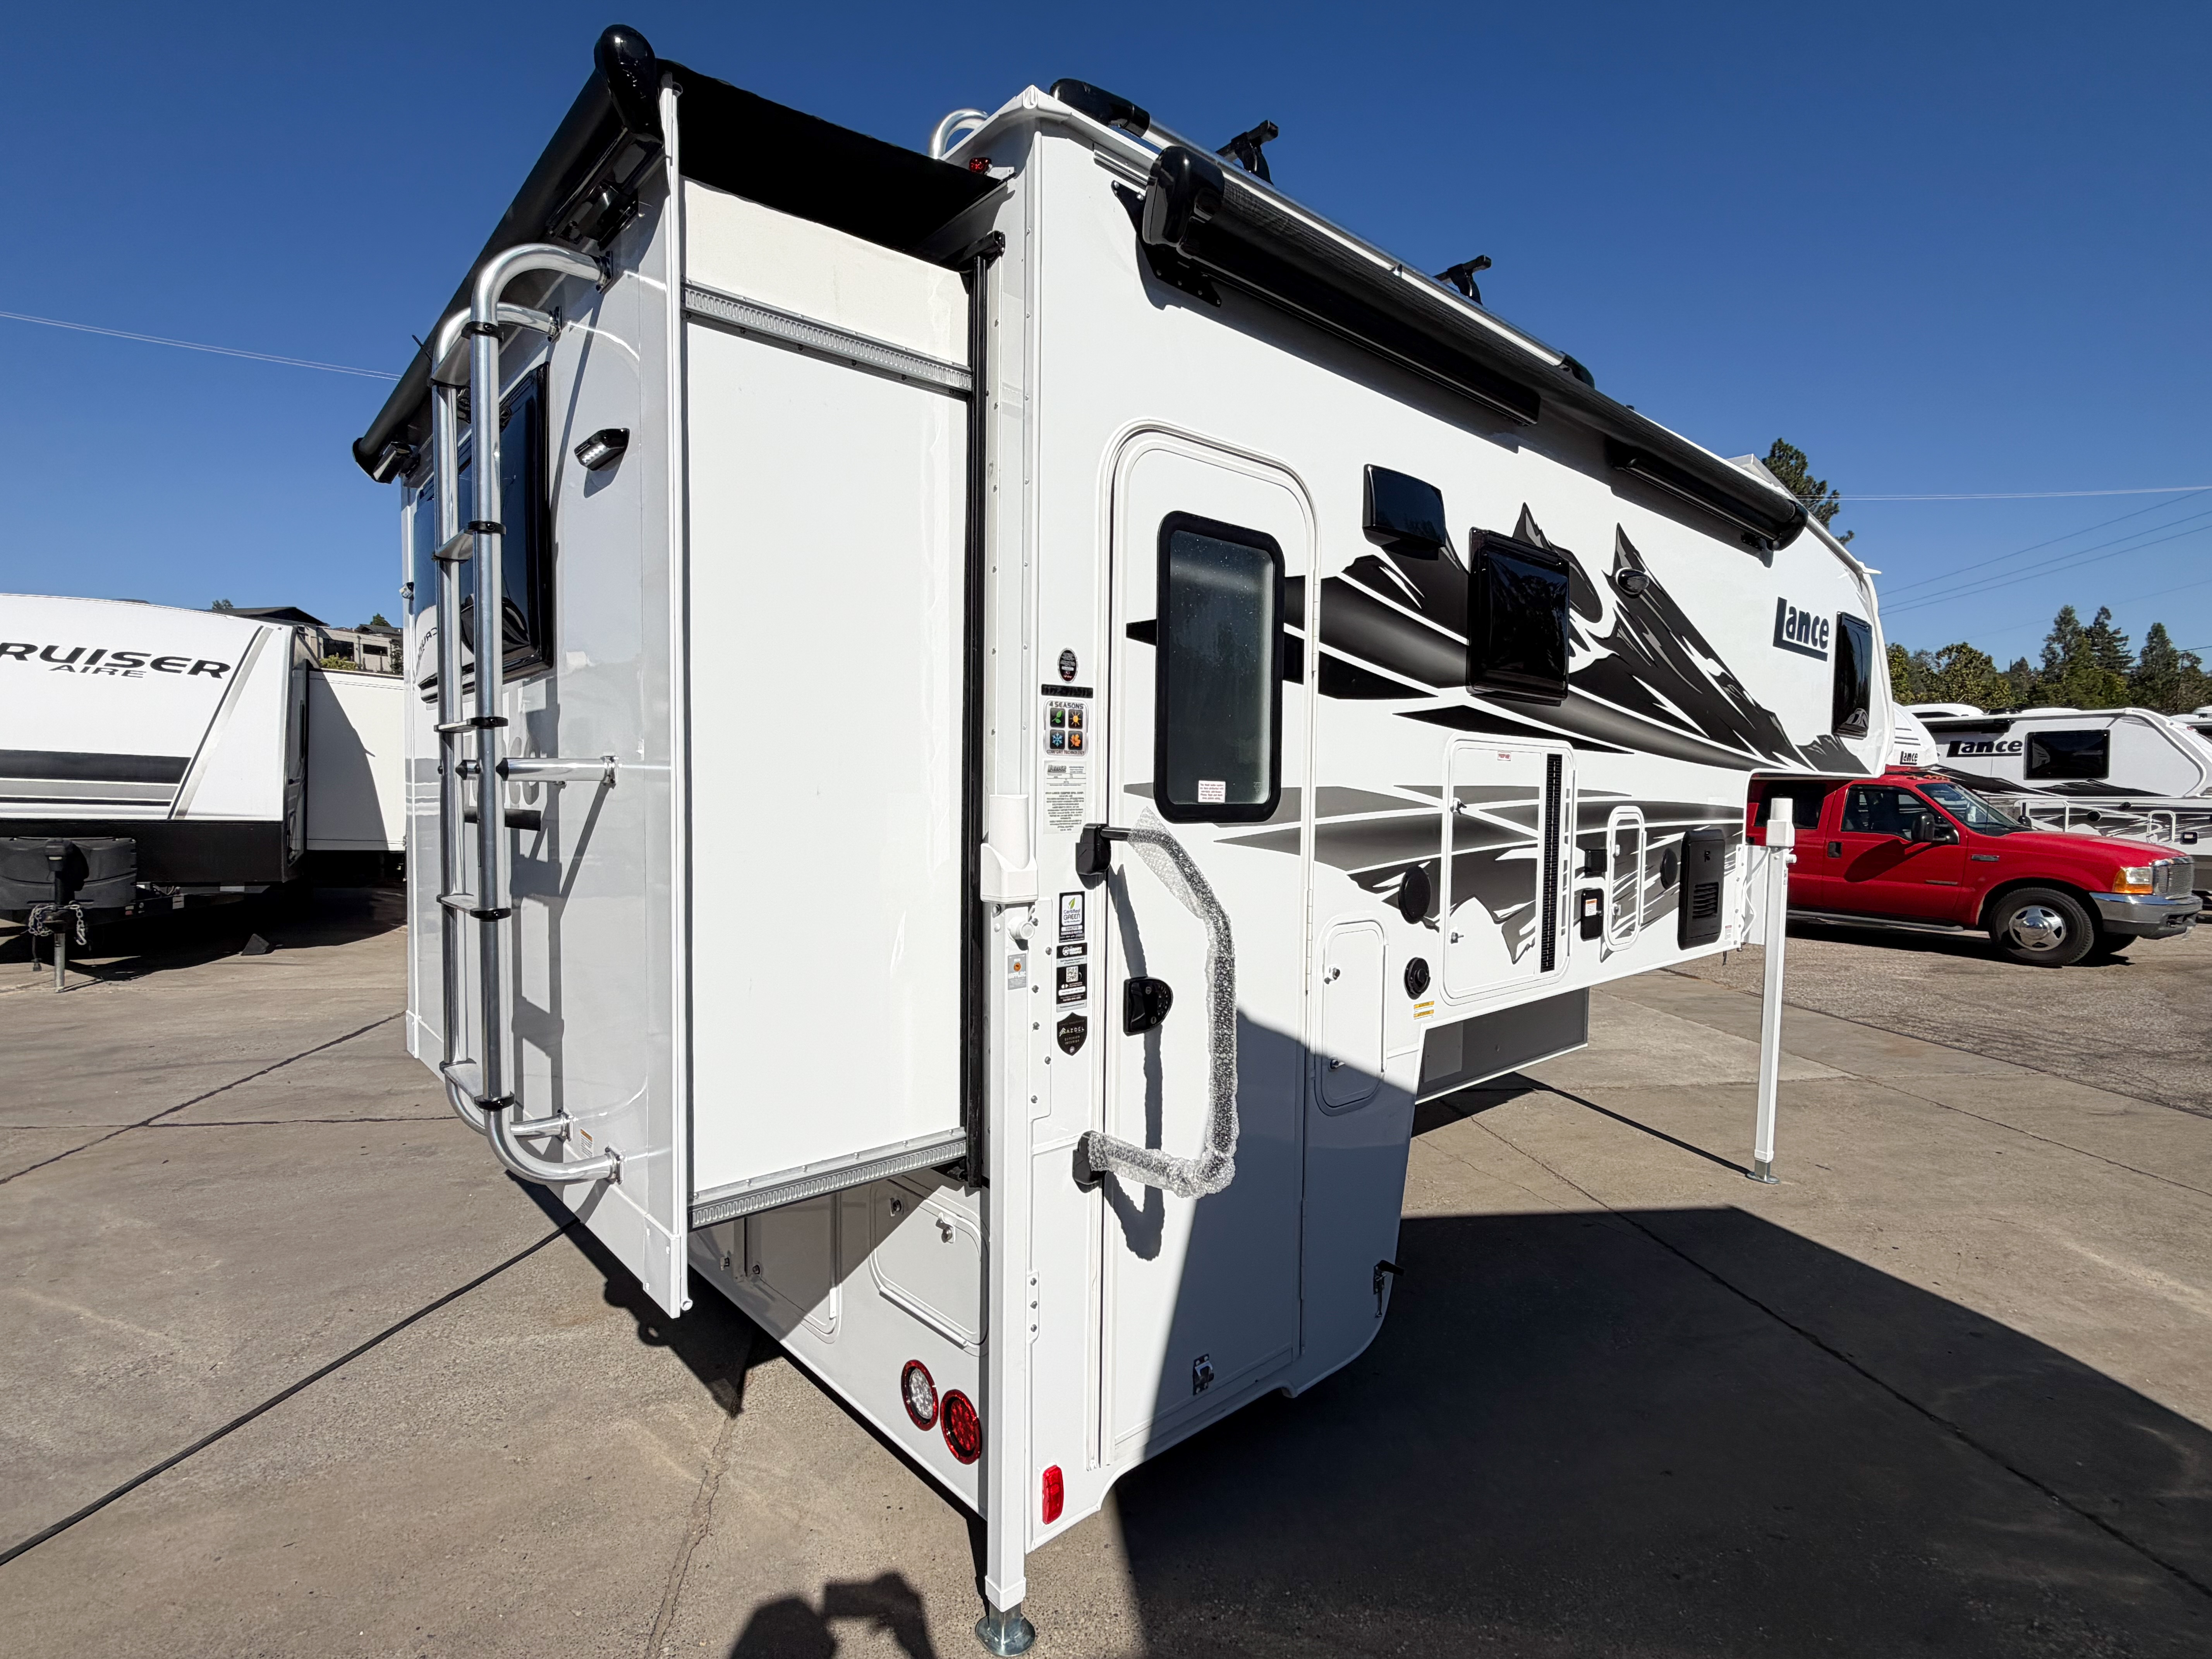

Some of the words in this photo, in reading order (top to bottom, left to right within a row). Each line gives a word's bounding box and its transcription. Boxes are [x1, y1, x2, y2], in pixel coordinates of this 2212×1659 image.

[1772, 596, 1829, 662] Lance
[0, 642, 231, 679] RUISER
[48, 665, 147, 678] AIRE
[1946, 740, 2023, 757] Lance
[1899, 751, 1918, 765] Lance
